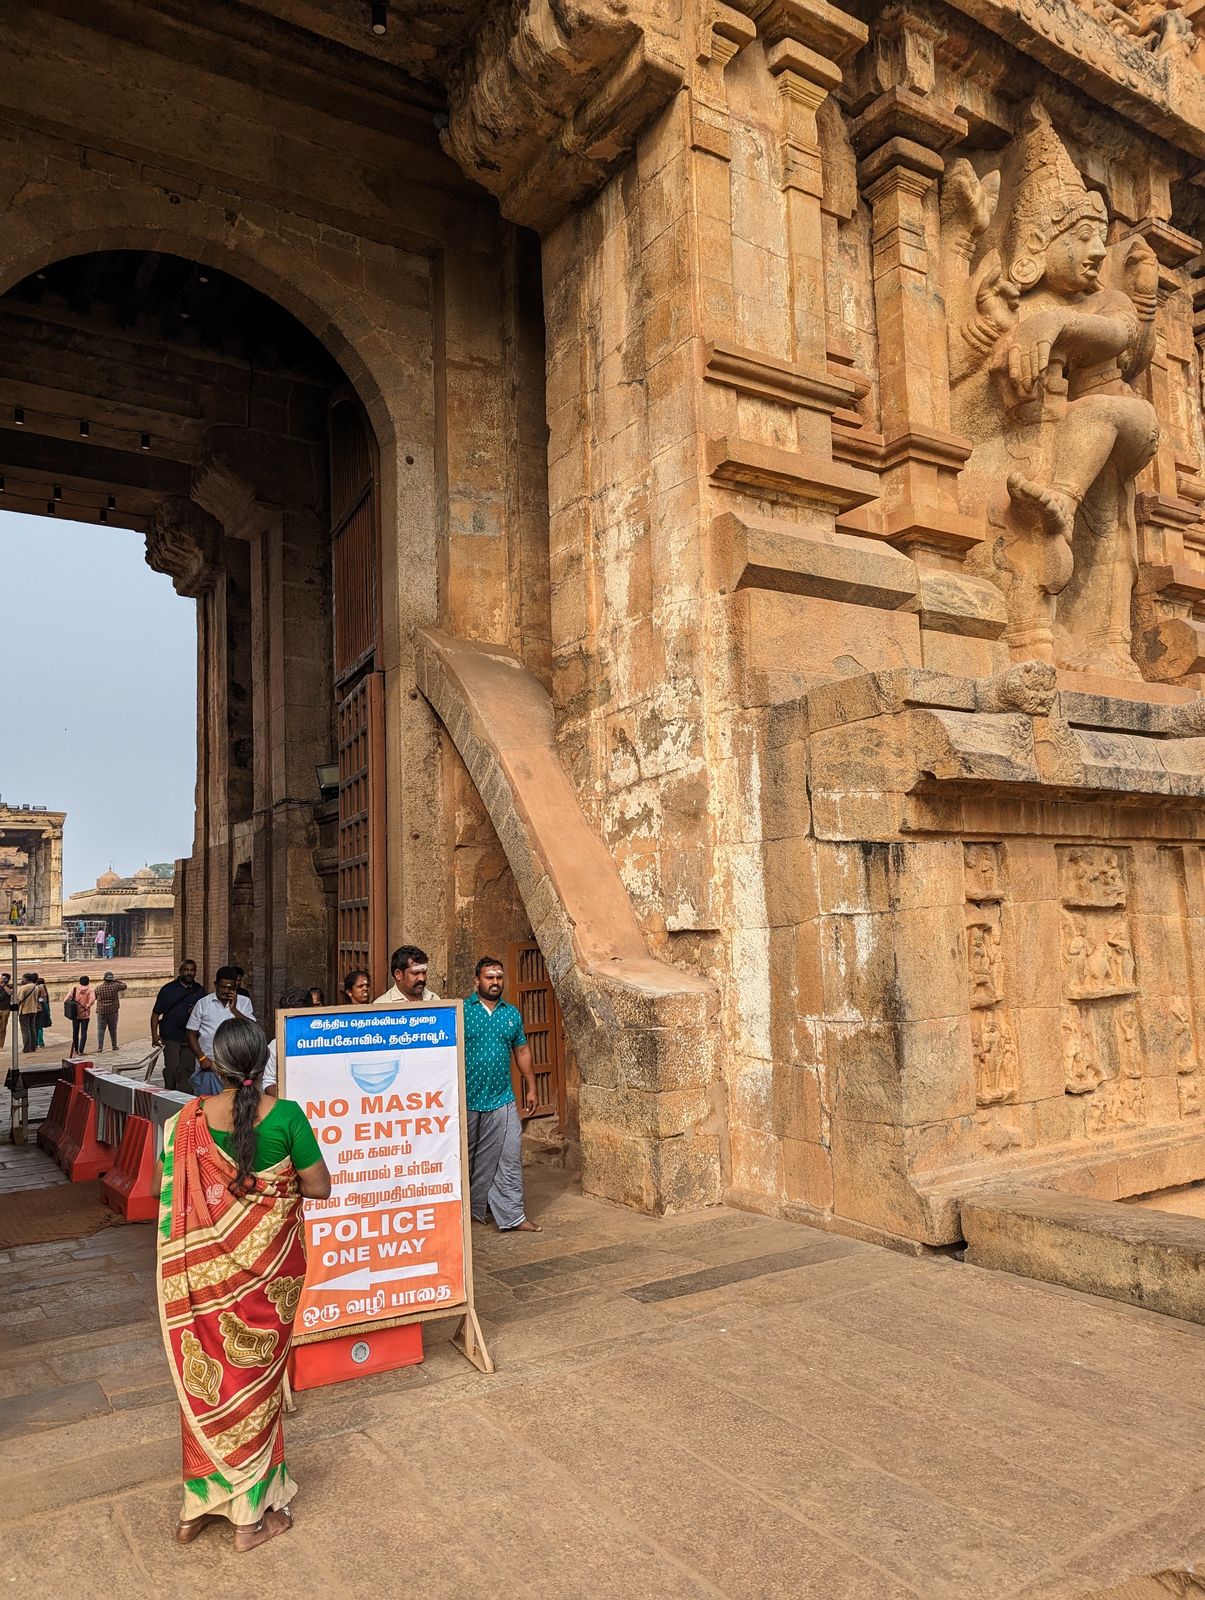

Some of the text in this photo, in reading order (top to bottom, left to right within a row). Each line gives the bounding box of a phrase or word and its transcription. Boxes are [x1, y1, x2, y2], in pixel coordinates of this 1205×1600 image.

[310, 1015, 437, 1031] இந்திய தொல்லியல் துறை
[297, 1029, 449, 1049] பெரியகோவில், தஞ்சாவூர்.
[306, 1090, 444, 1119] NO MASK
[354, 1115, 451, 1142] ENTRY
[338, 1140, 412, 1164] முக கவசம்
[394, 1160, 444, 1177] உள்ளே
[312, 1208, 435, 1246] POLICE
[322, 1237, 426, 1267] ONE WAY
[303, 1284, 451, 1328] ஒரு வழி பாதை
